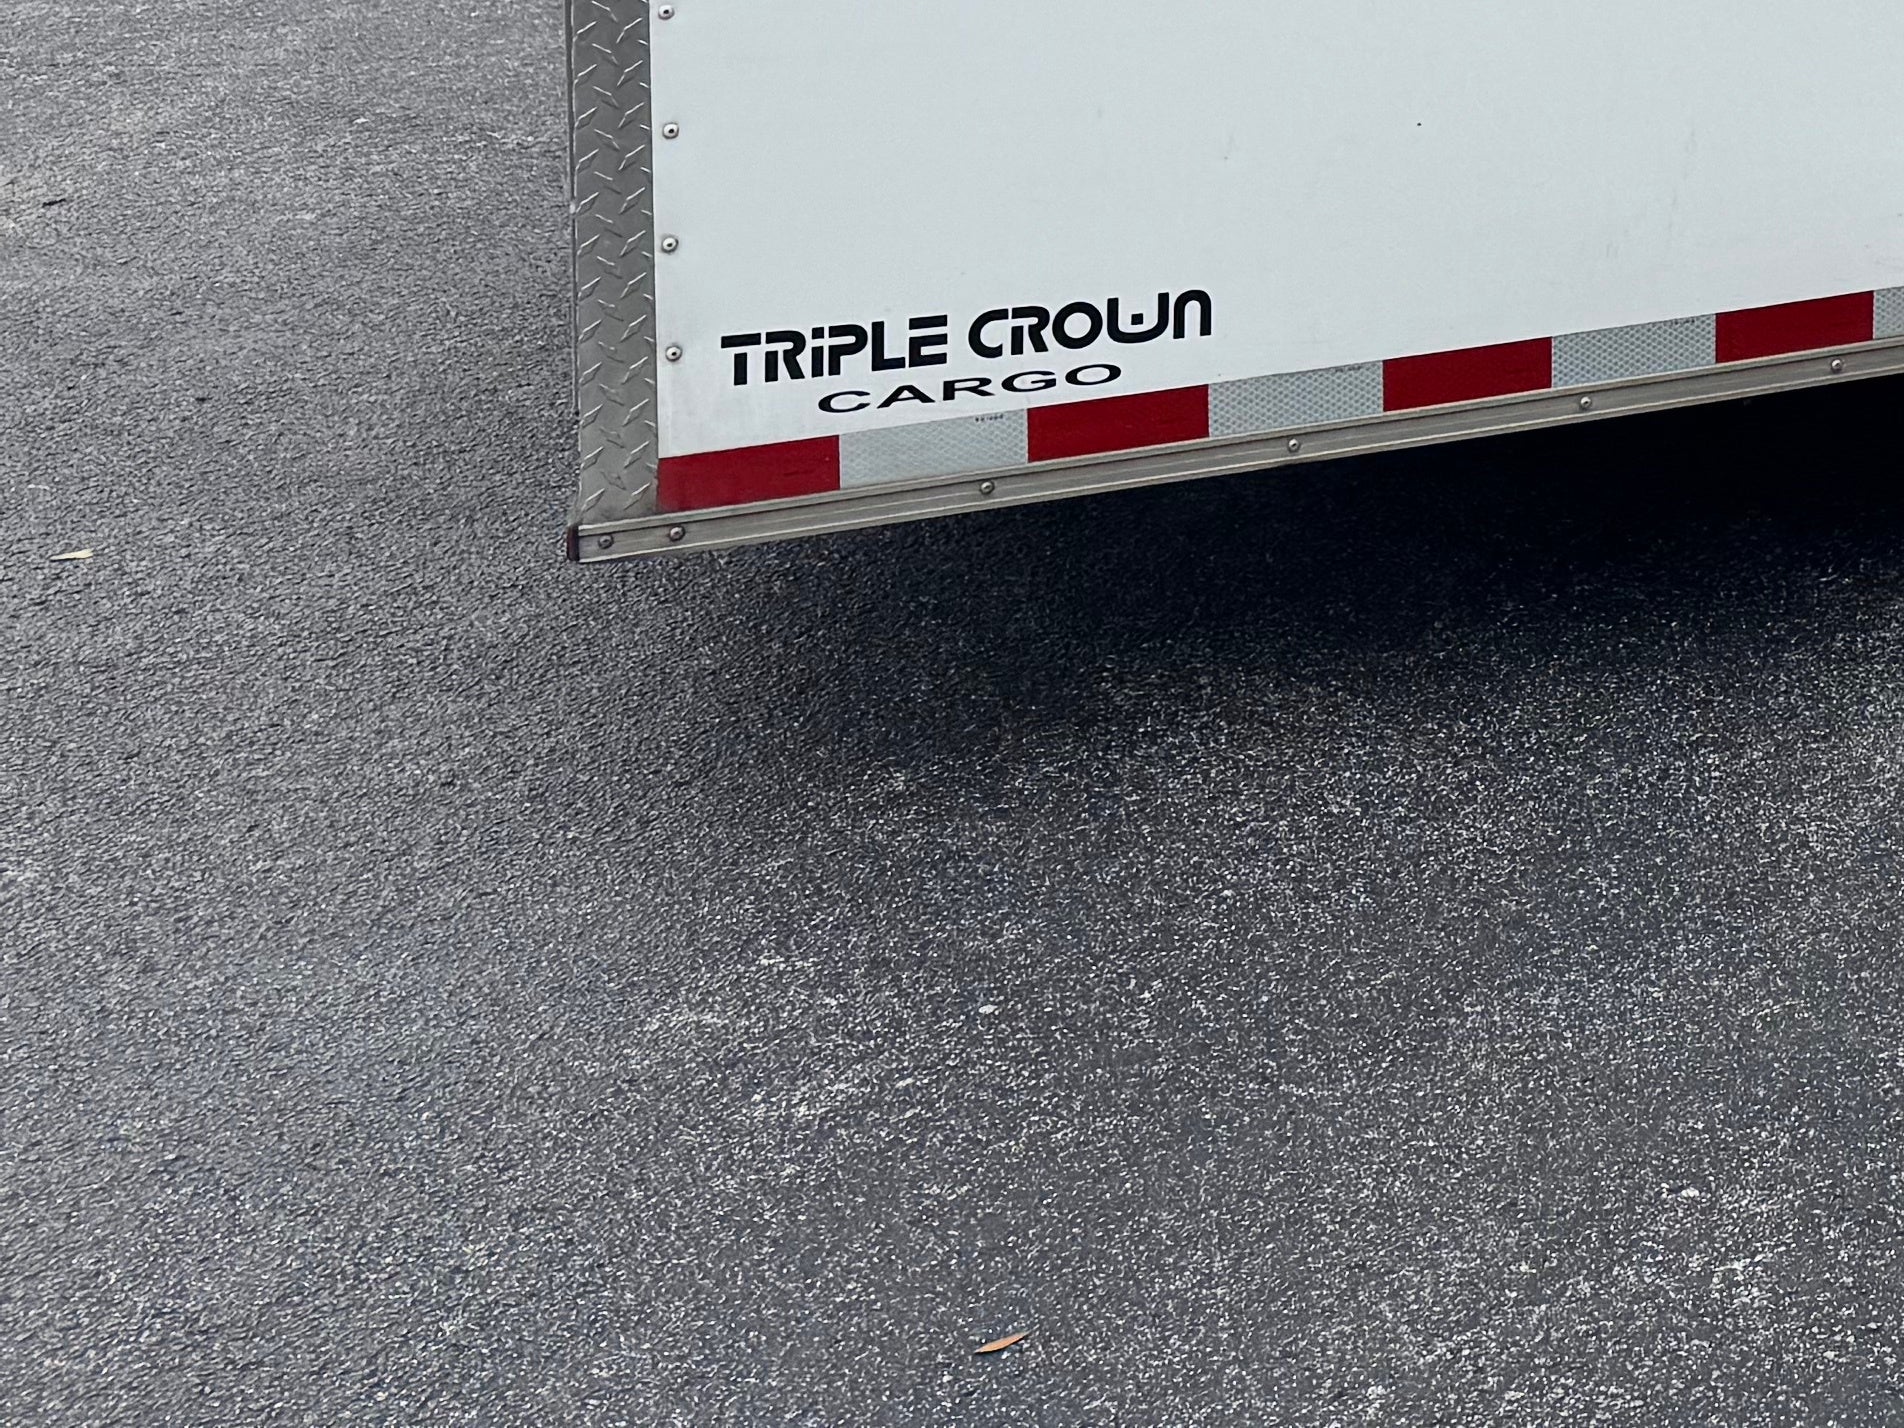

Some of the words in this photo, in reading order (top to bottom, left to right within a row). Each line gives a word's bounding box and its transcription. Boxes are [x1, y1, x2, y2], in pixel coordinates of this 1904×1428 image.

[720, 314, 948, 386] TRIPLE
[968, 289, 1212, 359] CROWN
[818, 363, 1122, 414] CARGO
